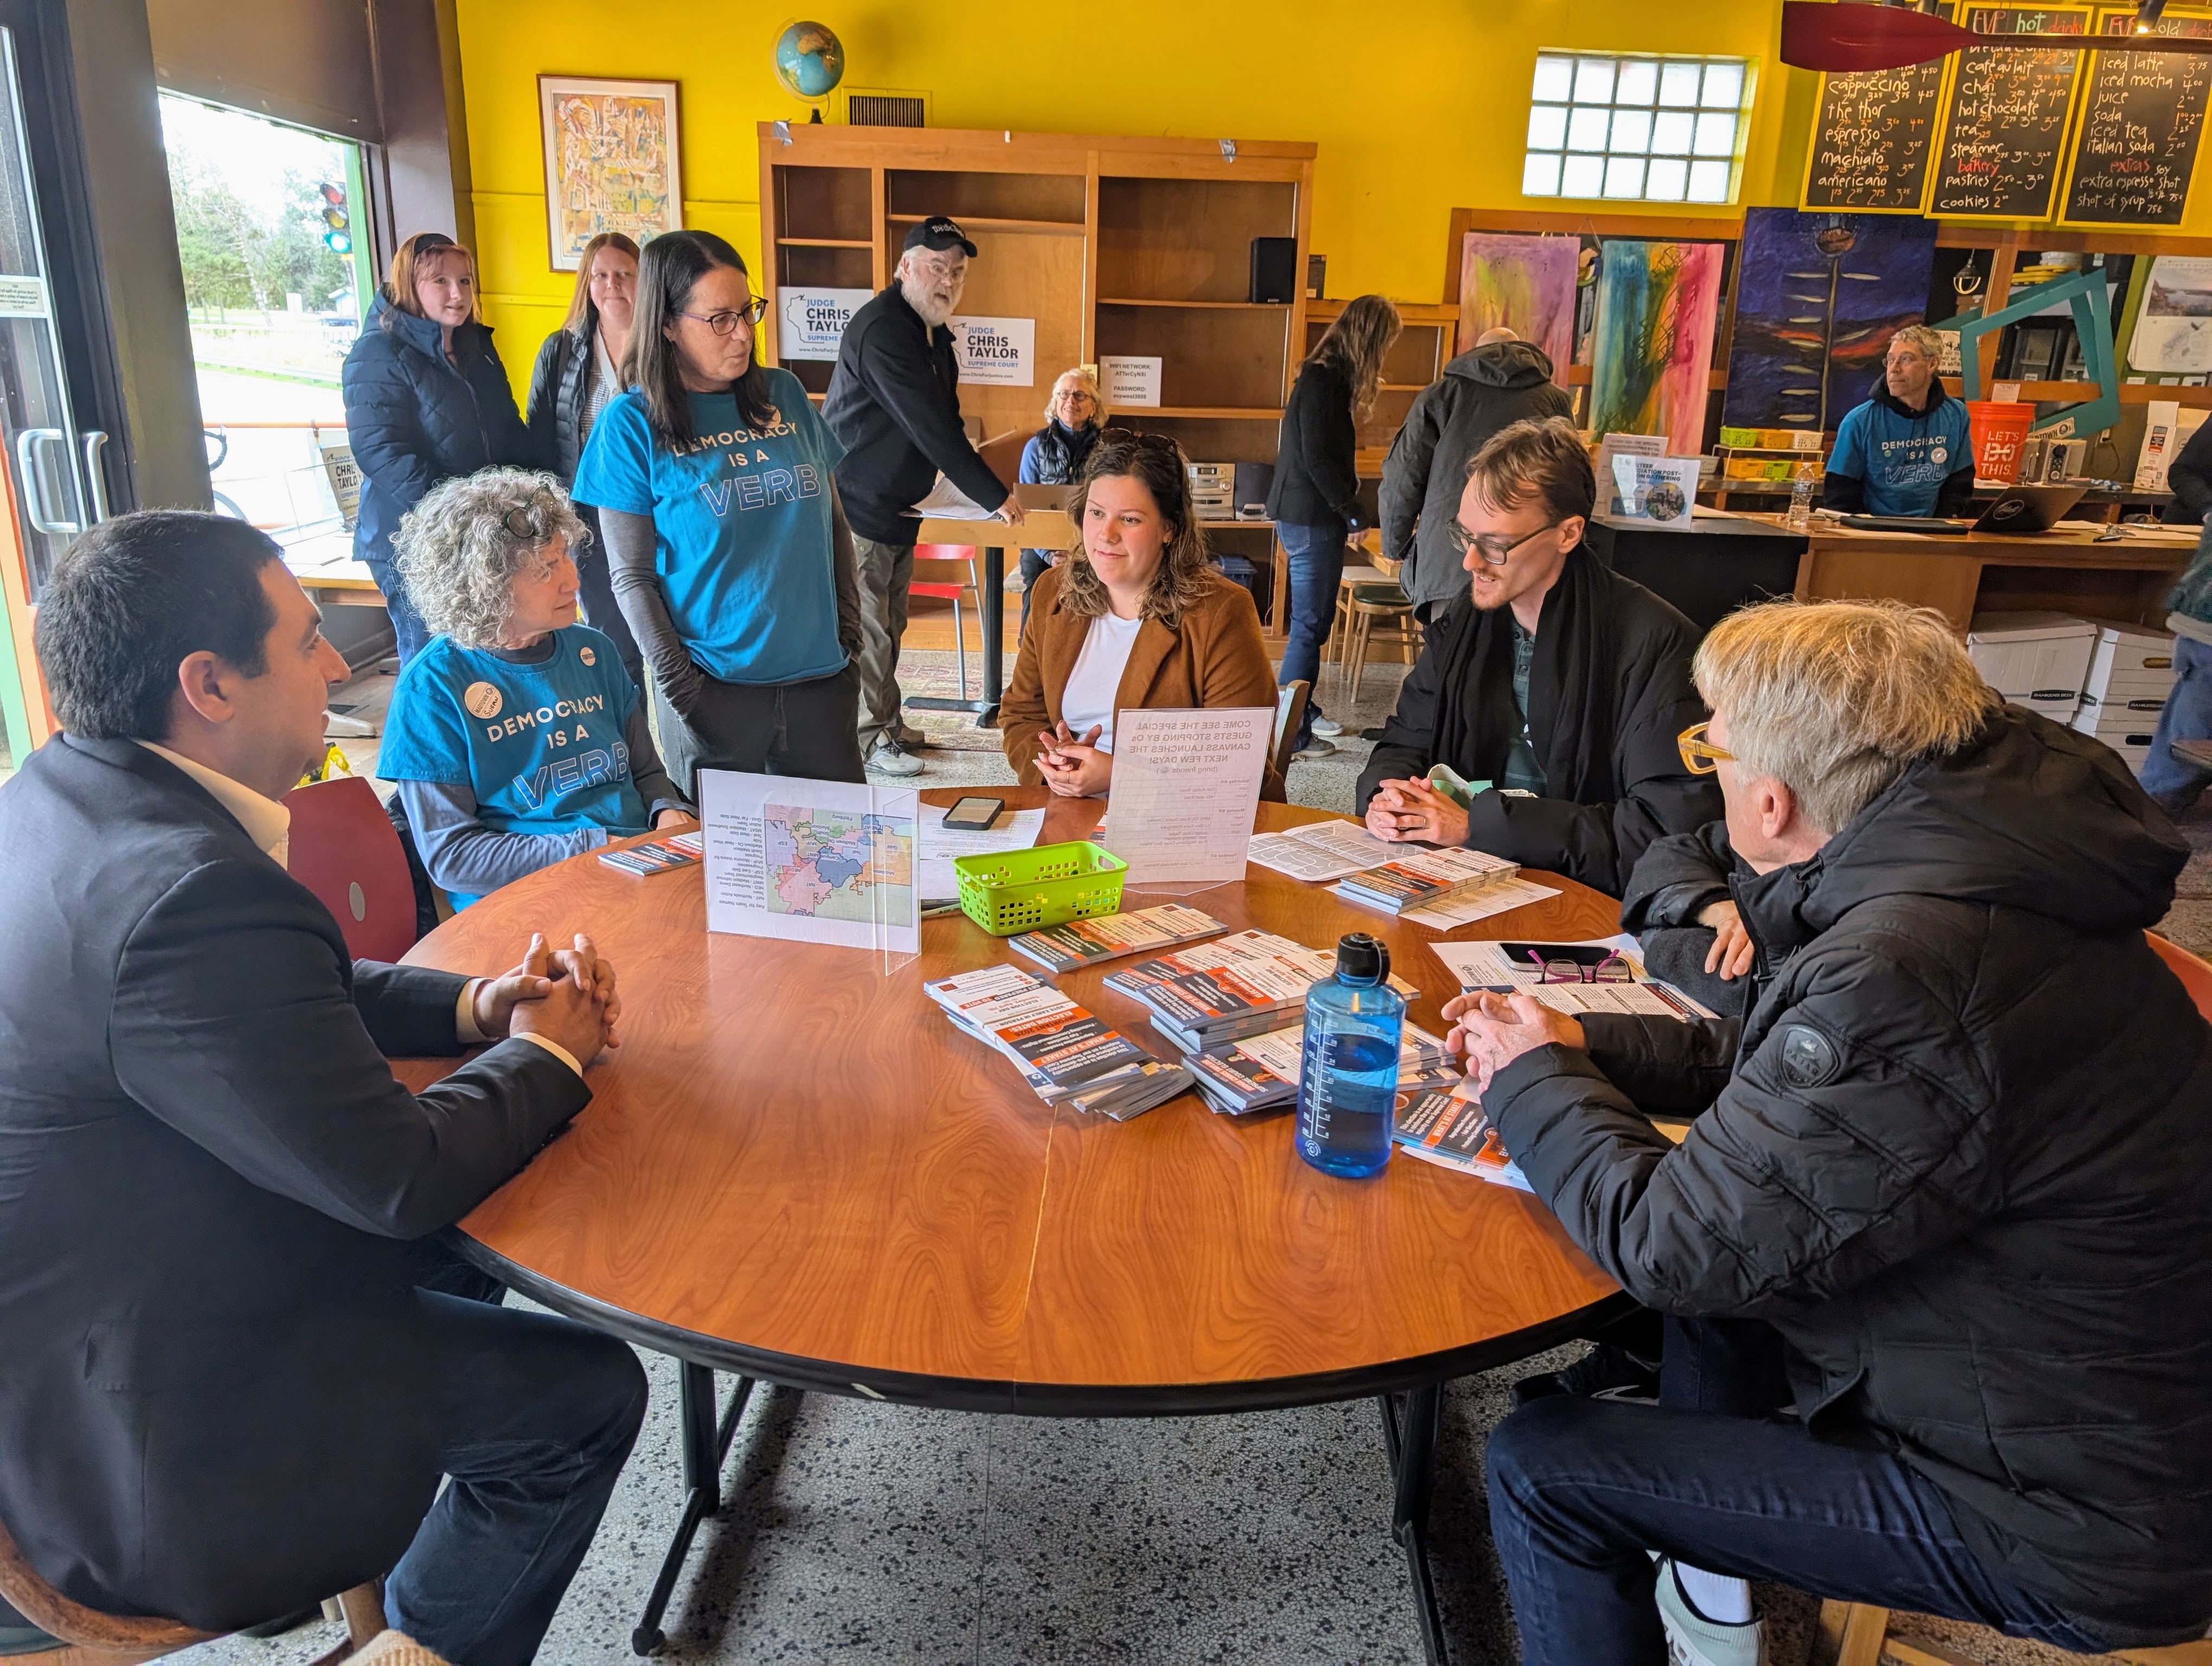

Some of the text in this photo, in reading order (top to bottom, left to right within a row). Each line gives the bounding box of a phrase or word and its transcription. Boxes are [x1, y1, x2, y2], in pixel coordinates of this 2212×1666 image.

[2015, 12, 2047, 34] hot
[2152, 20, 2181, 37] old
[2012, 60, 2034, 78] lait
[2102, 55, 2128, 72] iced
[2133, 55, 2164, 72] latte
[1828, 79, 1909, 97] cappuccino
[1962, 78, 1995, 94] chai
[2099, 72, 2125, 88] iced
[2130, 72, 2174, 89] mocha
[1828, 98, 1886, 120] the thor
[1958, 98, 2040, 117] hot chocolate
[2094, 91, 2129, 110] juice
[2092, 106, 2122, 125] soda
[1825, 129, 1880, 144] espresso
[1954, 123, 1979, 138] tea
[2090, 123, 2118, 138] iced
[2125, 121, 2148, 139] tea
[1950, 142, 2004, 158] steamer
[2087, 137, 2123, 155] italian
[2127, 138, 2155, 156] soda
[1821, 145, 1884, 168] machiato
[1957, 157, 1999, 177] bakery
[2110, 157, 2172, 176] extras soy
[1818, 174, 1887, 188] americano
[1945, 173, 1990, 189] pastries
[2079, 171, 2181, 191] extra espresso shot
[1940, 195, 1989, 209] cookies
[2076, 192, 2102, 208] shot
[2104, 192, 2118, 209] of
[2119, 194, 2146, 213] syrup
[806, 299, 835, 307] JUDGE
[806, 308, 851, 320] CHRIS
[967, 326, 995, 335] JUDGE
[967, 335, 1009, 347] CHRIS
[967, 347, 1019, 359] TAYLOR
[1988, 431, 2020, 441] LET'S
[728, 449, 770, 467] IS A
[1983, 442, 2016, 462] DO
[1885, 463, 1943, 484] VERB
[699, 463, 821, 517] VERB
[474, 694, 490, 714] MADTOWN
[487, 695, 604, 743] DEMOCRACY
[546, 724, 590, 749] IS A
[512, 741, 630, 810] VERB
[964, 998, 985, 1009] VOTE
[1050, 1005, 1065, 1013] VOTE
[999, 1016, 1023, 1026] PERSON
[1008, 1011, 1073, 1032] ELECTION DATES:
[1040, 1050, 1066, 1063] STAKE?
[1448, 1101, 1462, 1118] STAKE?
